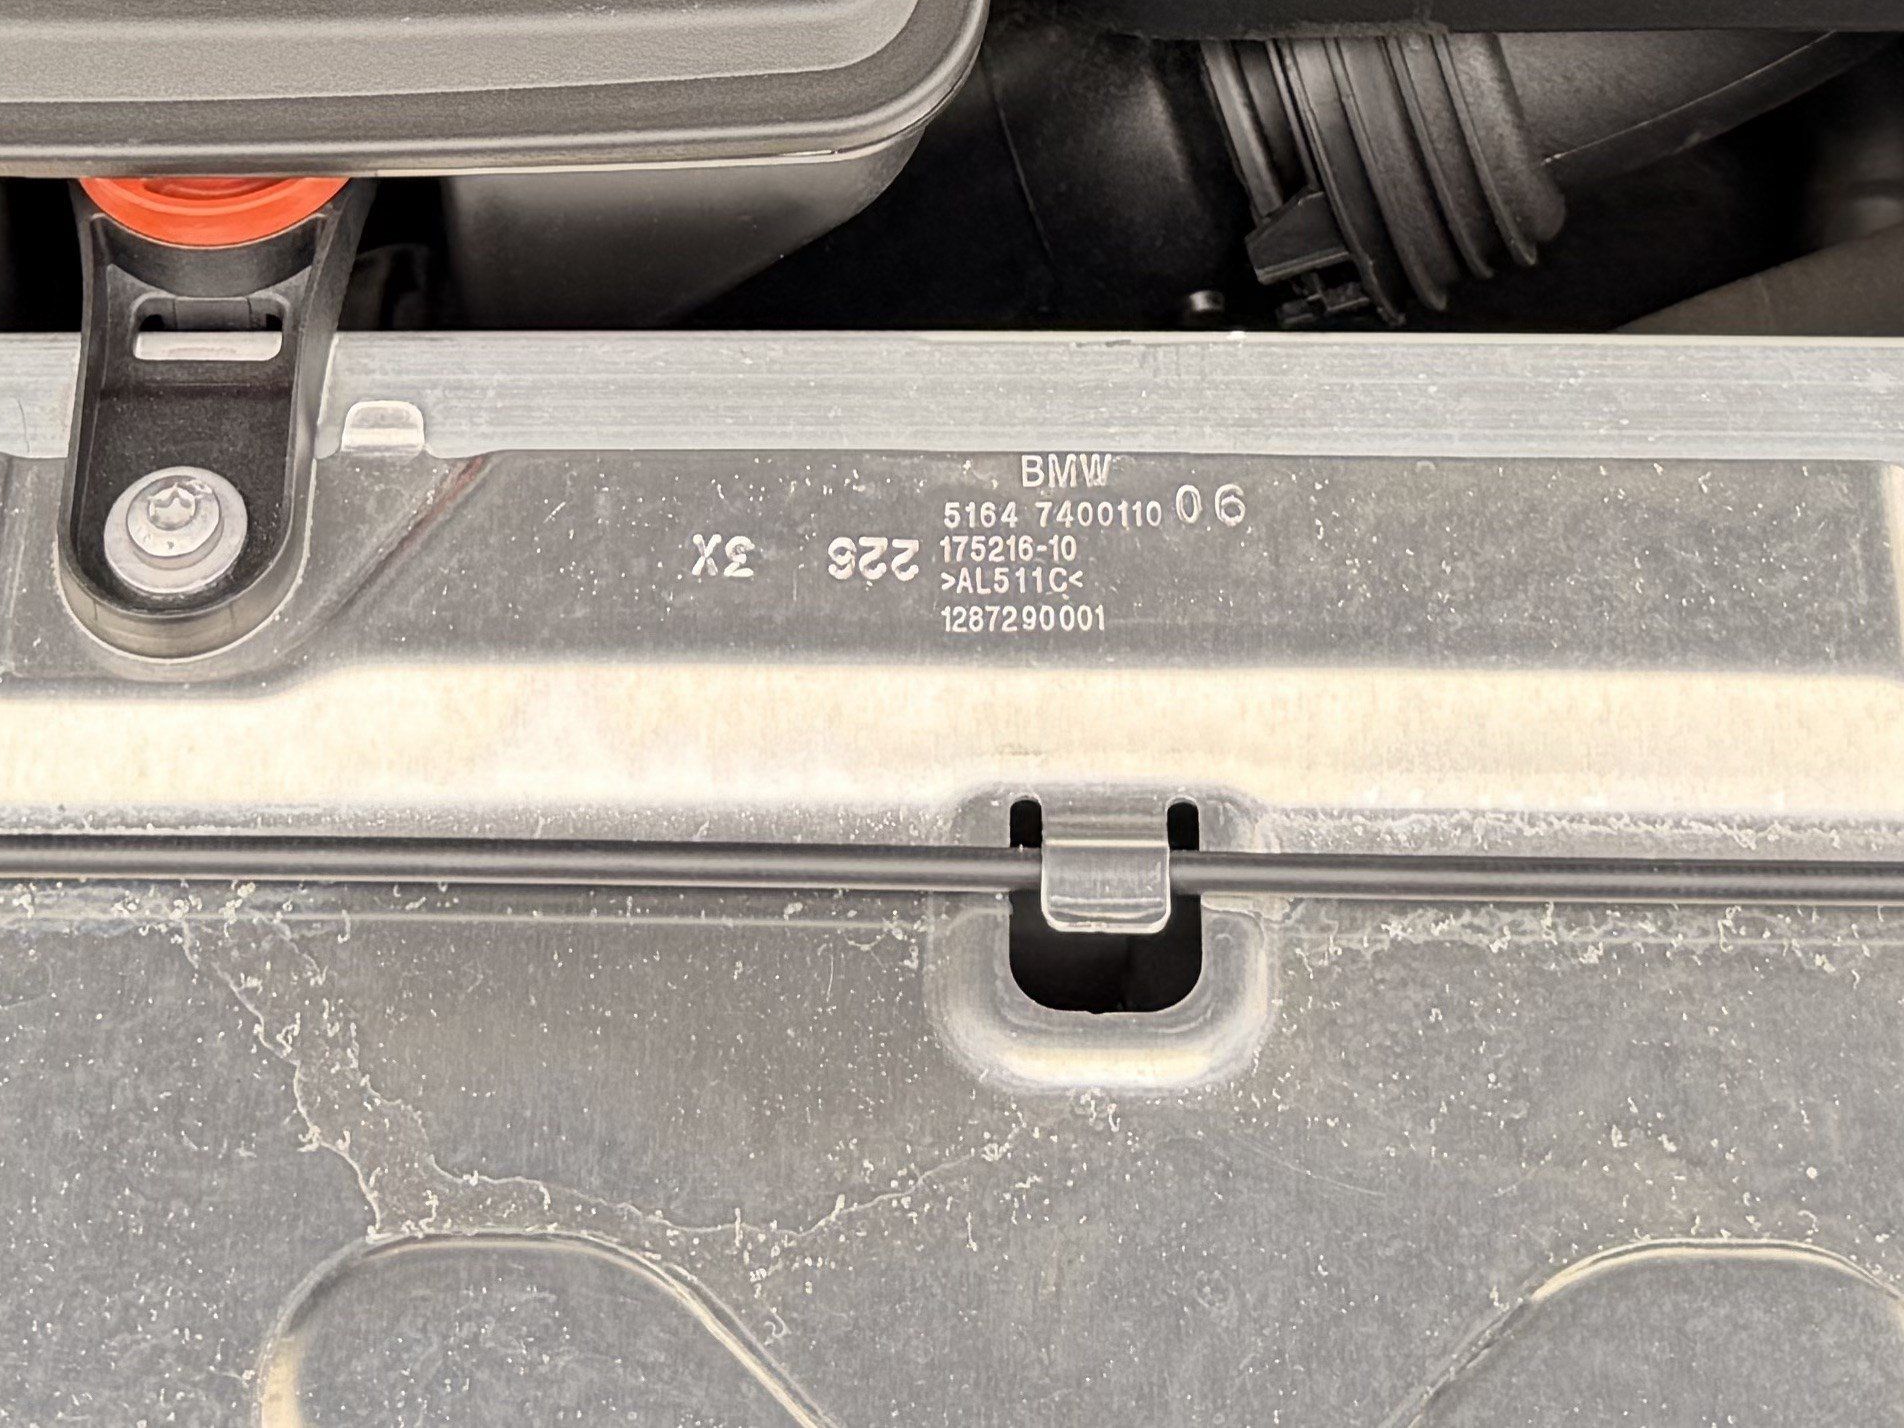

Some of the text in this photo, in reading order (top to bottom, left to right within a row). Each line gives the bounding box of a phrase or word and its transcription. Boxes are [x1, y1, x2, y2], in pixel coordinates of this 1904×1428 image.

[1021, 453, 1112, 488] BMW
[944, 500, 1162, 528] 5164 7400110
[940, 534, 1077, 563] 175216-10
[940, 604, 1105, 632] 1287290001
